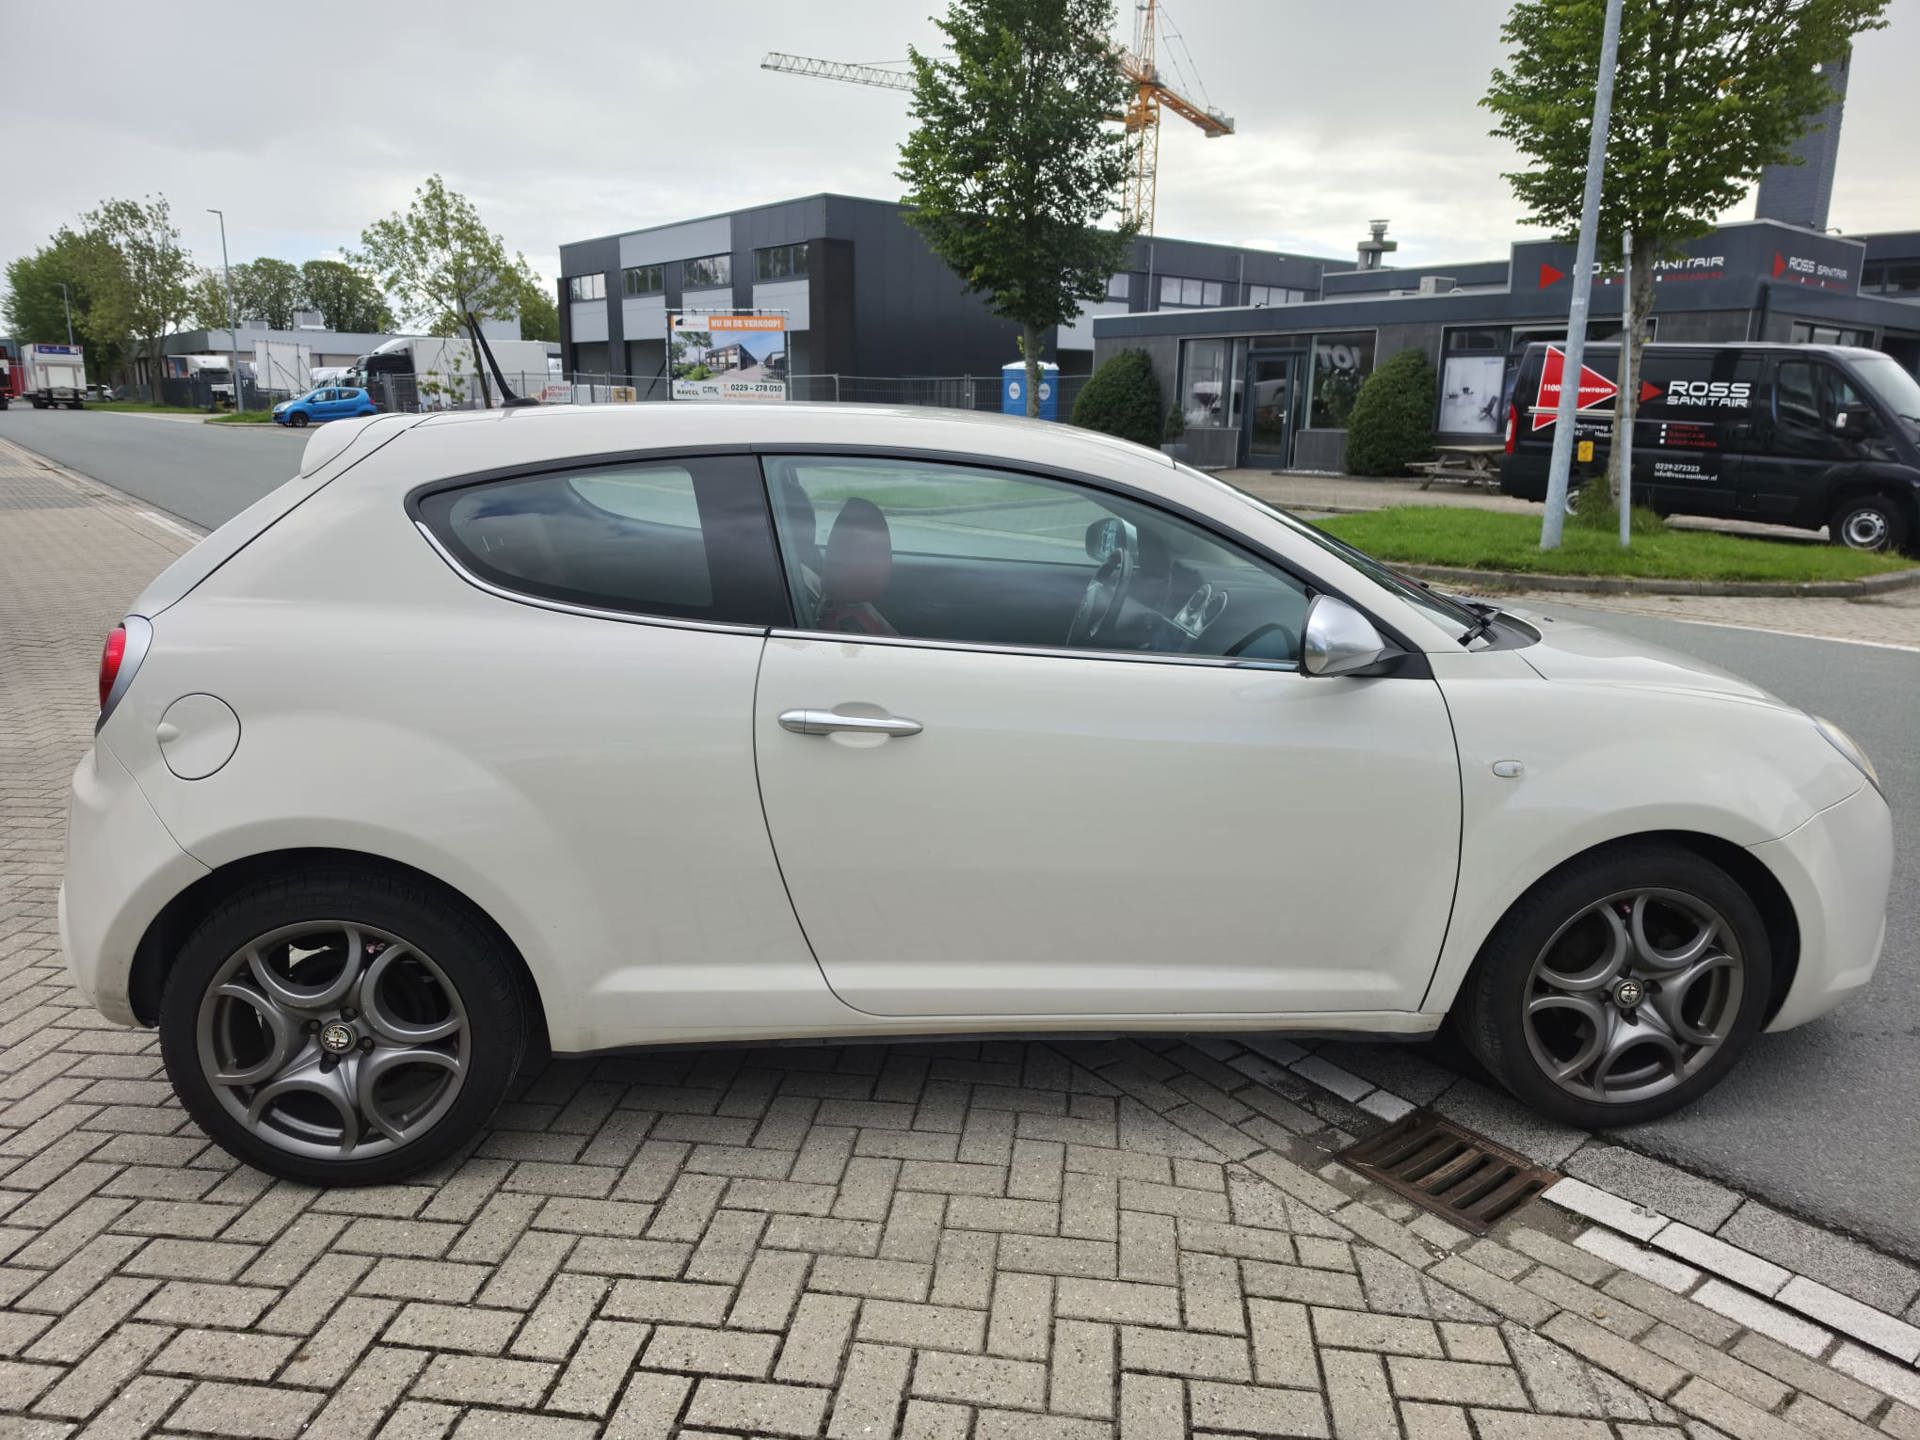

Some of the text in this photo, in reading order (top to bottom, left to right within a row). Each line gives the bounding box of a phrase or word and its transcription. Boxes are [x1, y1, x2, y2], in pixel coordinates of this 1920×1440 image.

[1651, 256, 1725, 271] ANITAIR
[1788, 256, 1816, 273] ROSS
[1816, 264, 1848, 280] SANITAIR
[730, 384, 749, 392] 0229
[755, 384, 768, 392] 278
[769, 384, 783, 393] 010
[1668, 380, 1751, 398] ROSS
[1666, 396, 1748, 408] SANITAIR
